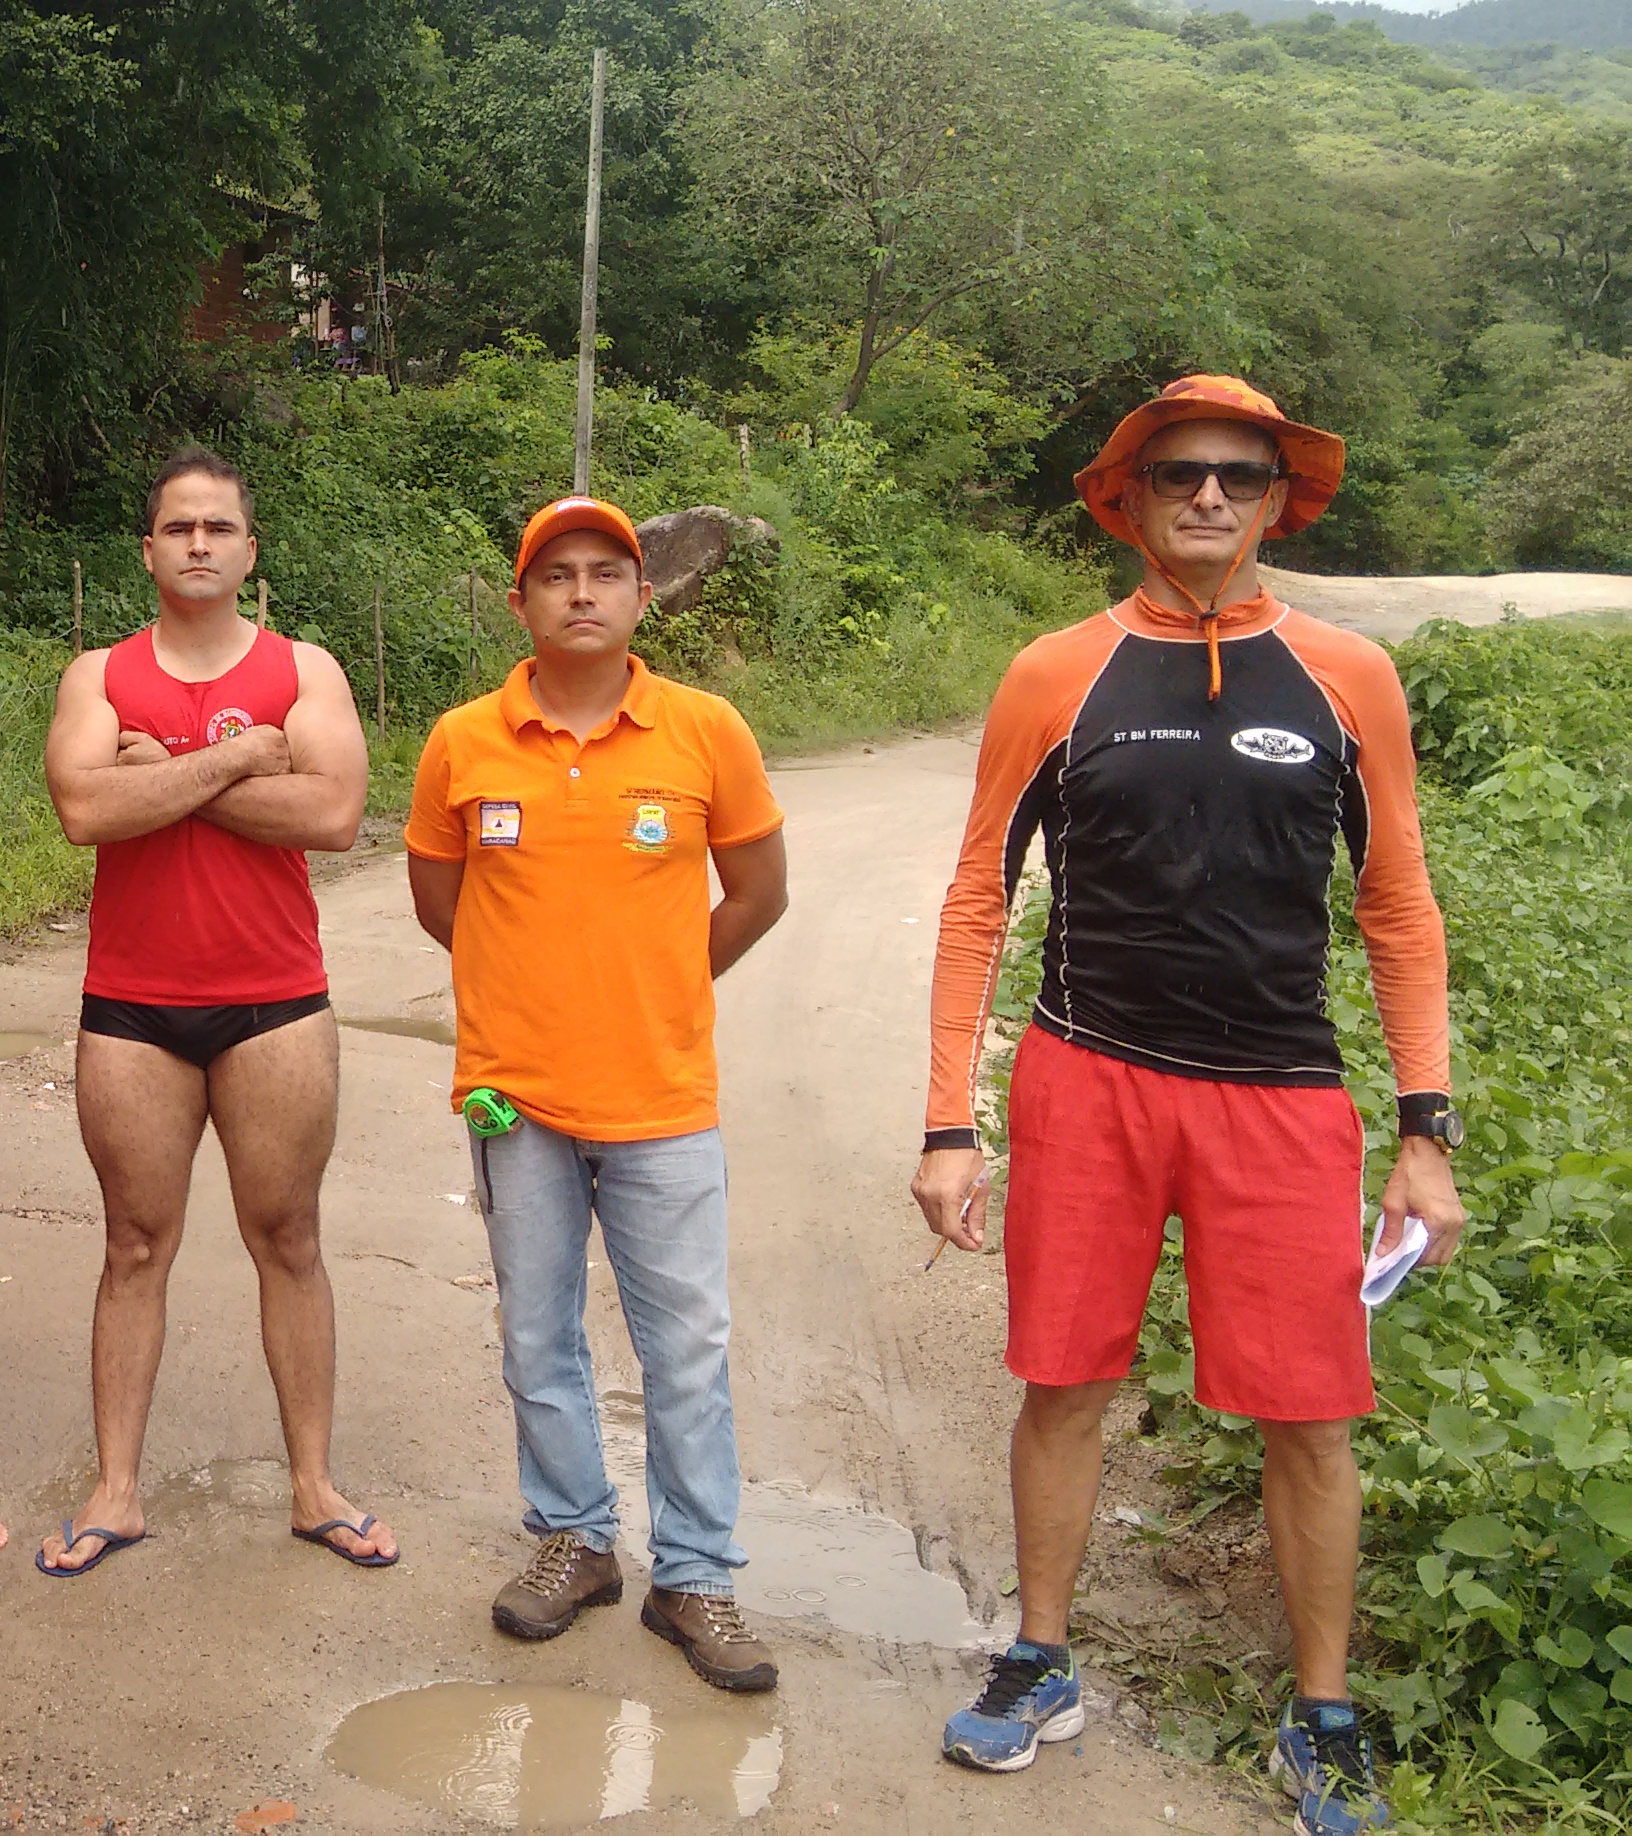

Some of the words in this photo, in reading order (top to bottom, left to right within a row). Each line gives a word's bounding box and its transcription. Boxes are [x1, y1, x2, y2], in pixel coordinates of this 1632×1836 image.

[1114, 732, 1127, 743] ST
[1131, 730, 1146, 740] BM
[1150, 729, 1201, 741] FERREIRA
